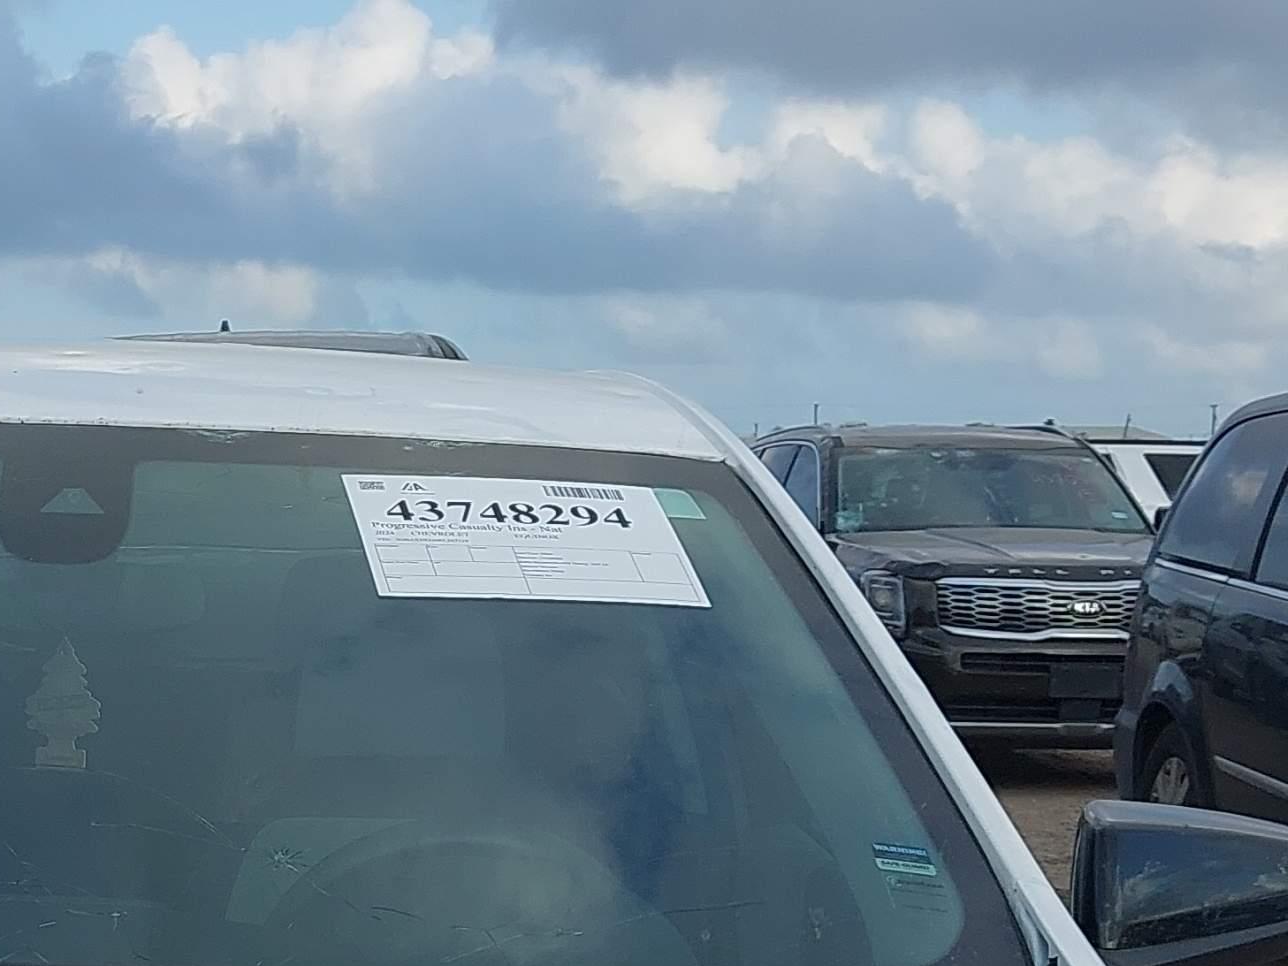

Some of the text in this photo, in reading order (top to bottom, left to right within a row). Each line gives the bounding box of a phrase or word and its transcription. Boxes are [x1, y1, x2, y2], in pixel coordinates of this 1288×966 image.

[386, 499, 632, 528] 43748294
[371, 521, 445, 530] Progressive
[448, 523, 502, 532] Casualty
[507, 524, 528, 532] Ins
[539, 525, 563, 533] Nat
[1074, 602, 1100, 613] KIA
